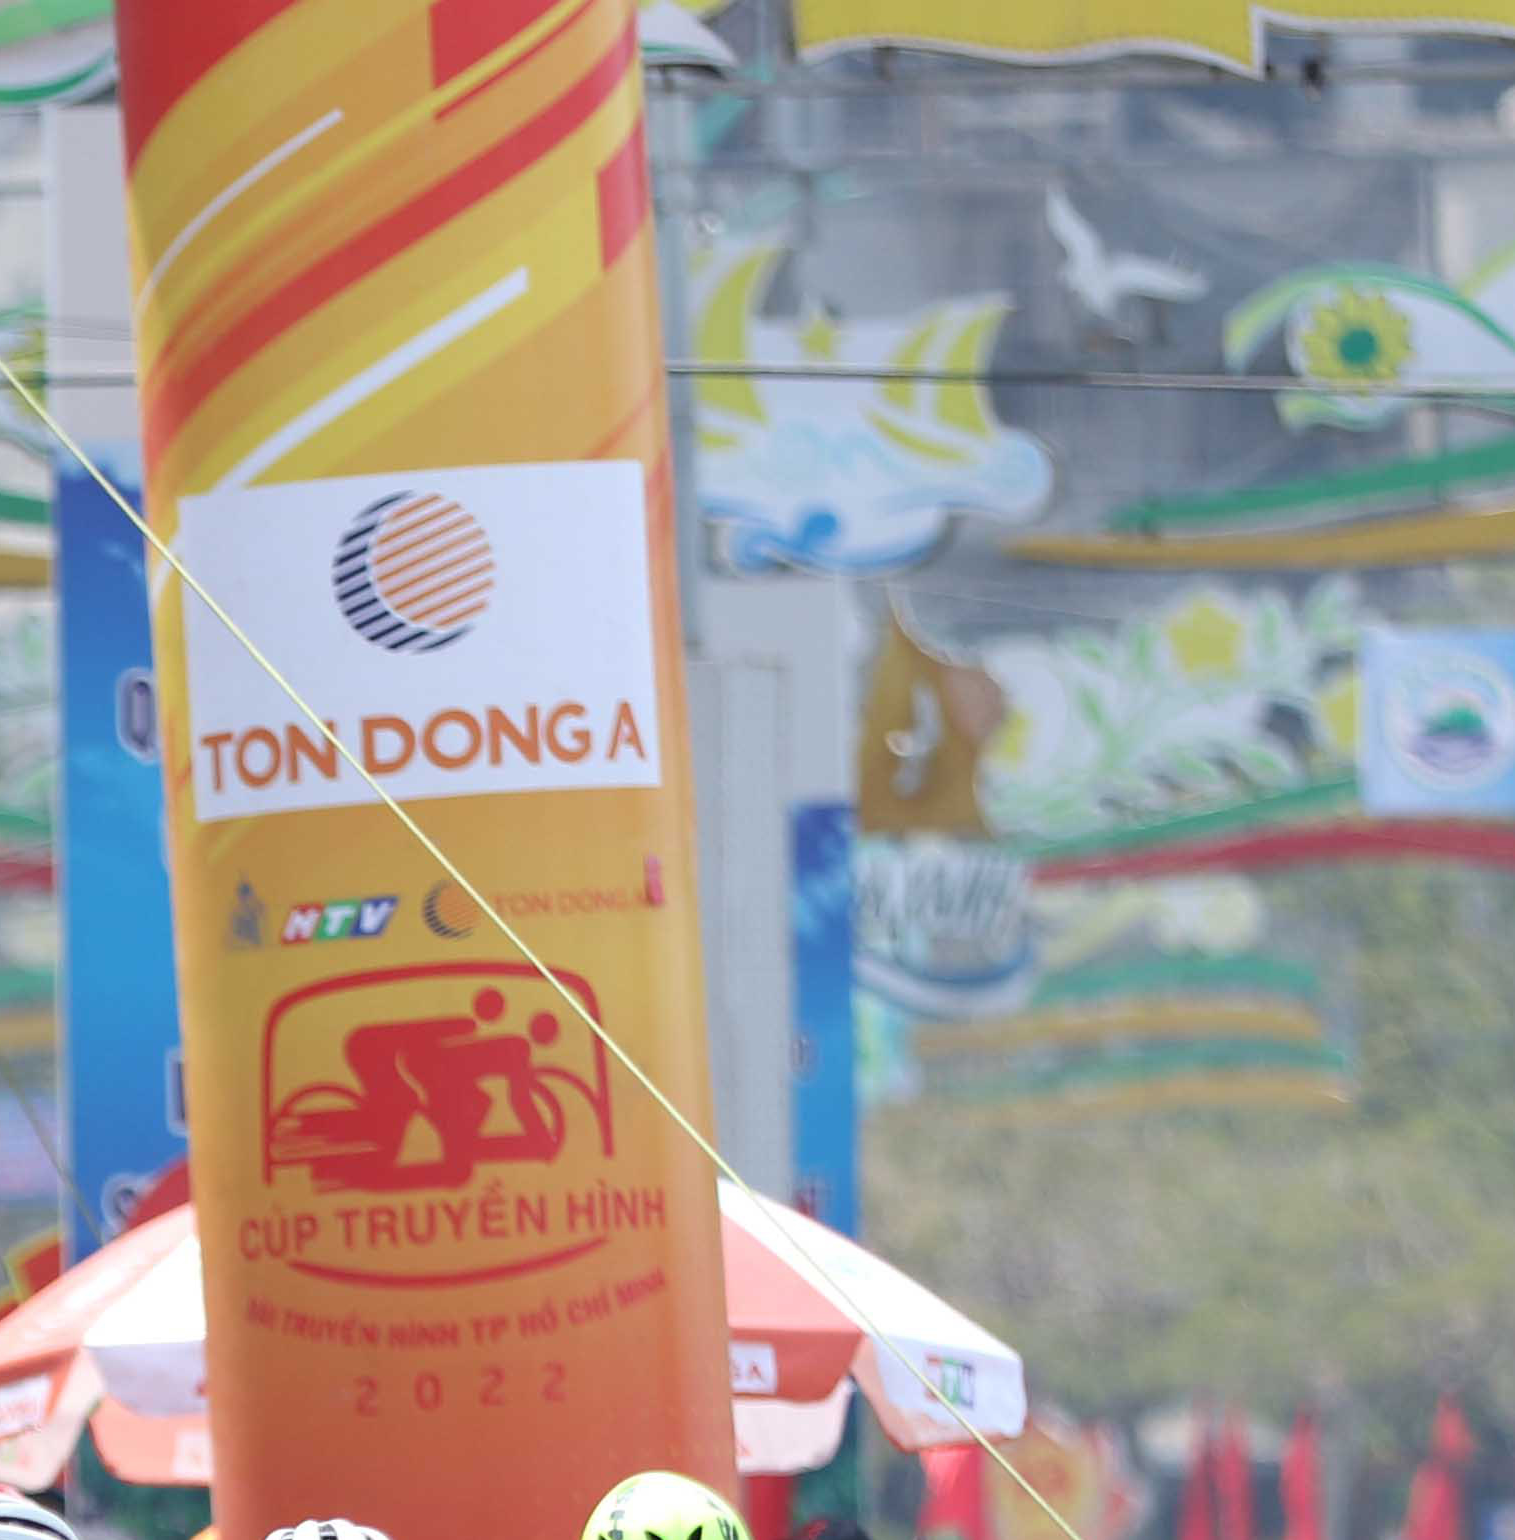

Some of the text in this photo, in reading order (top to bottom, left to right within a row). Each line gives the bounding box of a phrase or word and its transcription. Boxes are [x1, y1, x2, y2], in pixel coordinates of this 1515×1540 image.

[201, 702, 645, 793] TON DONG A
[283, 898, 397, 943] HTV
